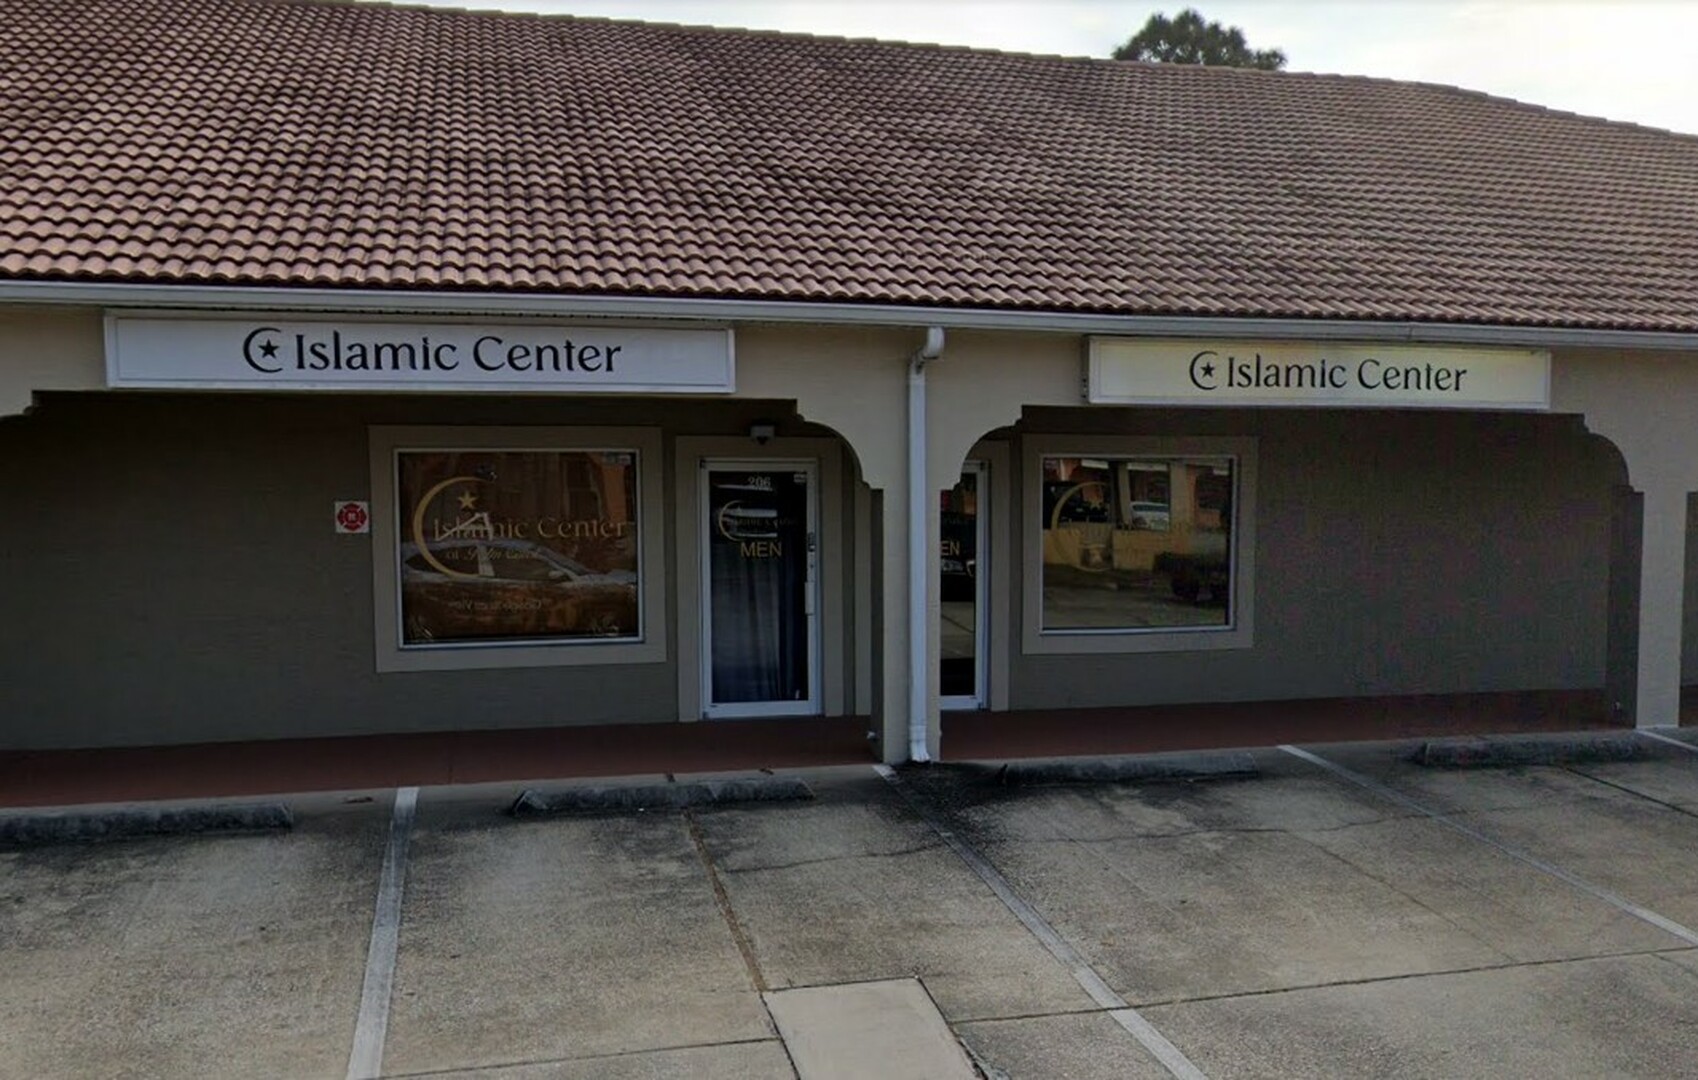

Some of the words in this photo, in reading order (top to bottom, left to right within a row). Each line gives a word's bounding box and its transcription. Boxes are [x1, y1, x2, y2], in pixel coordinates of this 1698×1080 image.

[296, 331, 458, 371] Islamic
[474, 336, 622, 373] Center
[1228, 354, 1348, 389] Islamic
[1357, 359, 1467, 392] Center
[538, 517, 627, 539] Center
[740, 541, 783, 558] MEN
